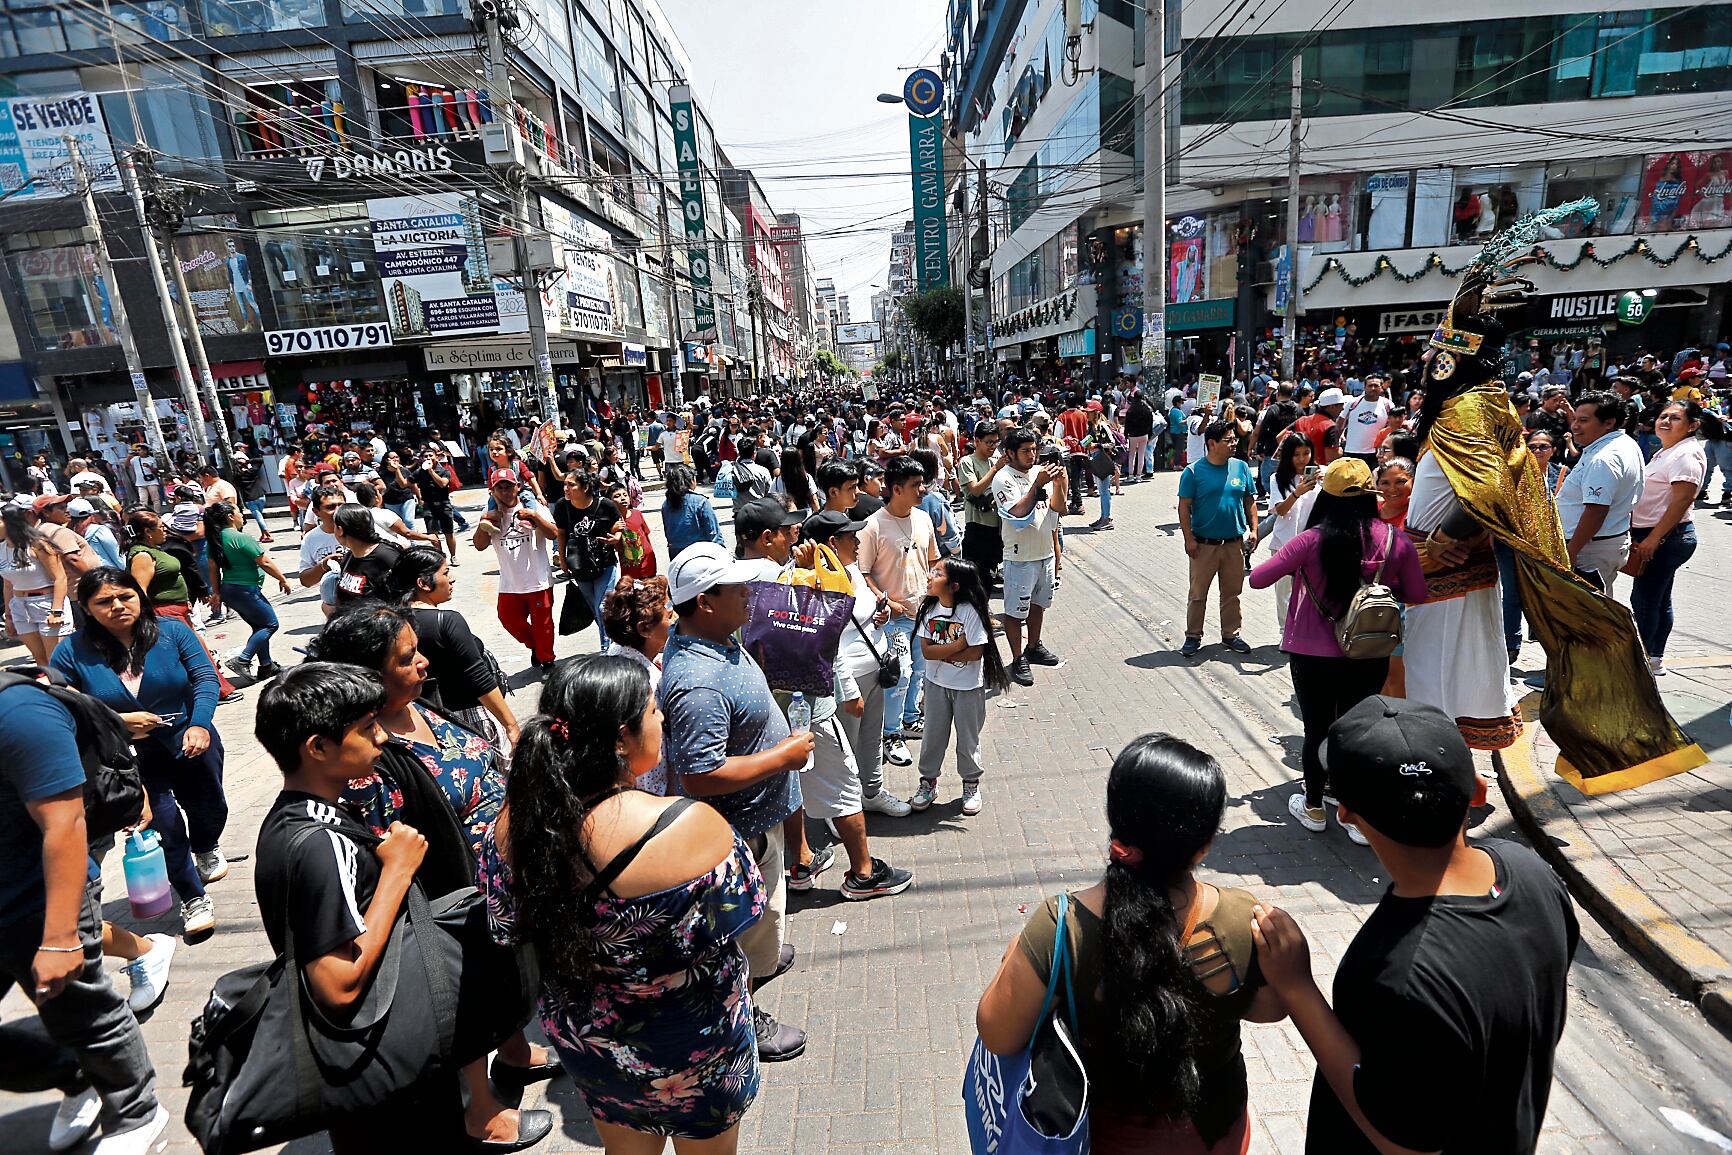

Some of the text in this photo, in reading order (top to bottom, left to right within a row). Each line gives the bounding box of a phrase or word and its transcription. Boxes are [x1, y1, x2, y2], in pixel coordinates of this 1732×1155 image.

[13, 97, 96, 130] SE VENDE
[333, 147, 452, 179] DAMARIS
[675, 109, 711, 306] SALOMON
[918, 125, 942, 282] CENTRO GAMARRA
[376, 215, 459, 231] SANTA CATALINA
[380, 230, 460, 246] LA VICTORIA
[409, 248, 445, 258] ESTEBAN
[179, 250, 216, 273] trevida
[384, 258, 442, 269] CAMPODÓNICO
[426, 264, 458, 272] CATALINA
[462, 298, 493, 306] CATALINA
[1550, 294, 1617, 318] HUSTLE
[268, 324, 390, 353] 970 110 791
[1533, 328, 1559, 336] CIERRA
[1560, 326, 1590, 335] PUERTAS
[429, 351, 444, 364] La
[450, 348, 501, 366] Séptima
[506, 348, 524, 361] de
[768, 610, 826, 626] FOOTLOOSE
[772, 620, 786, 628] Vive
